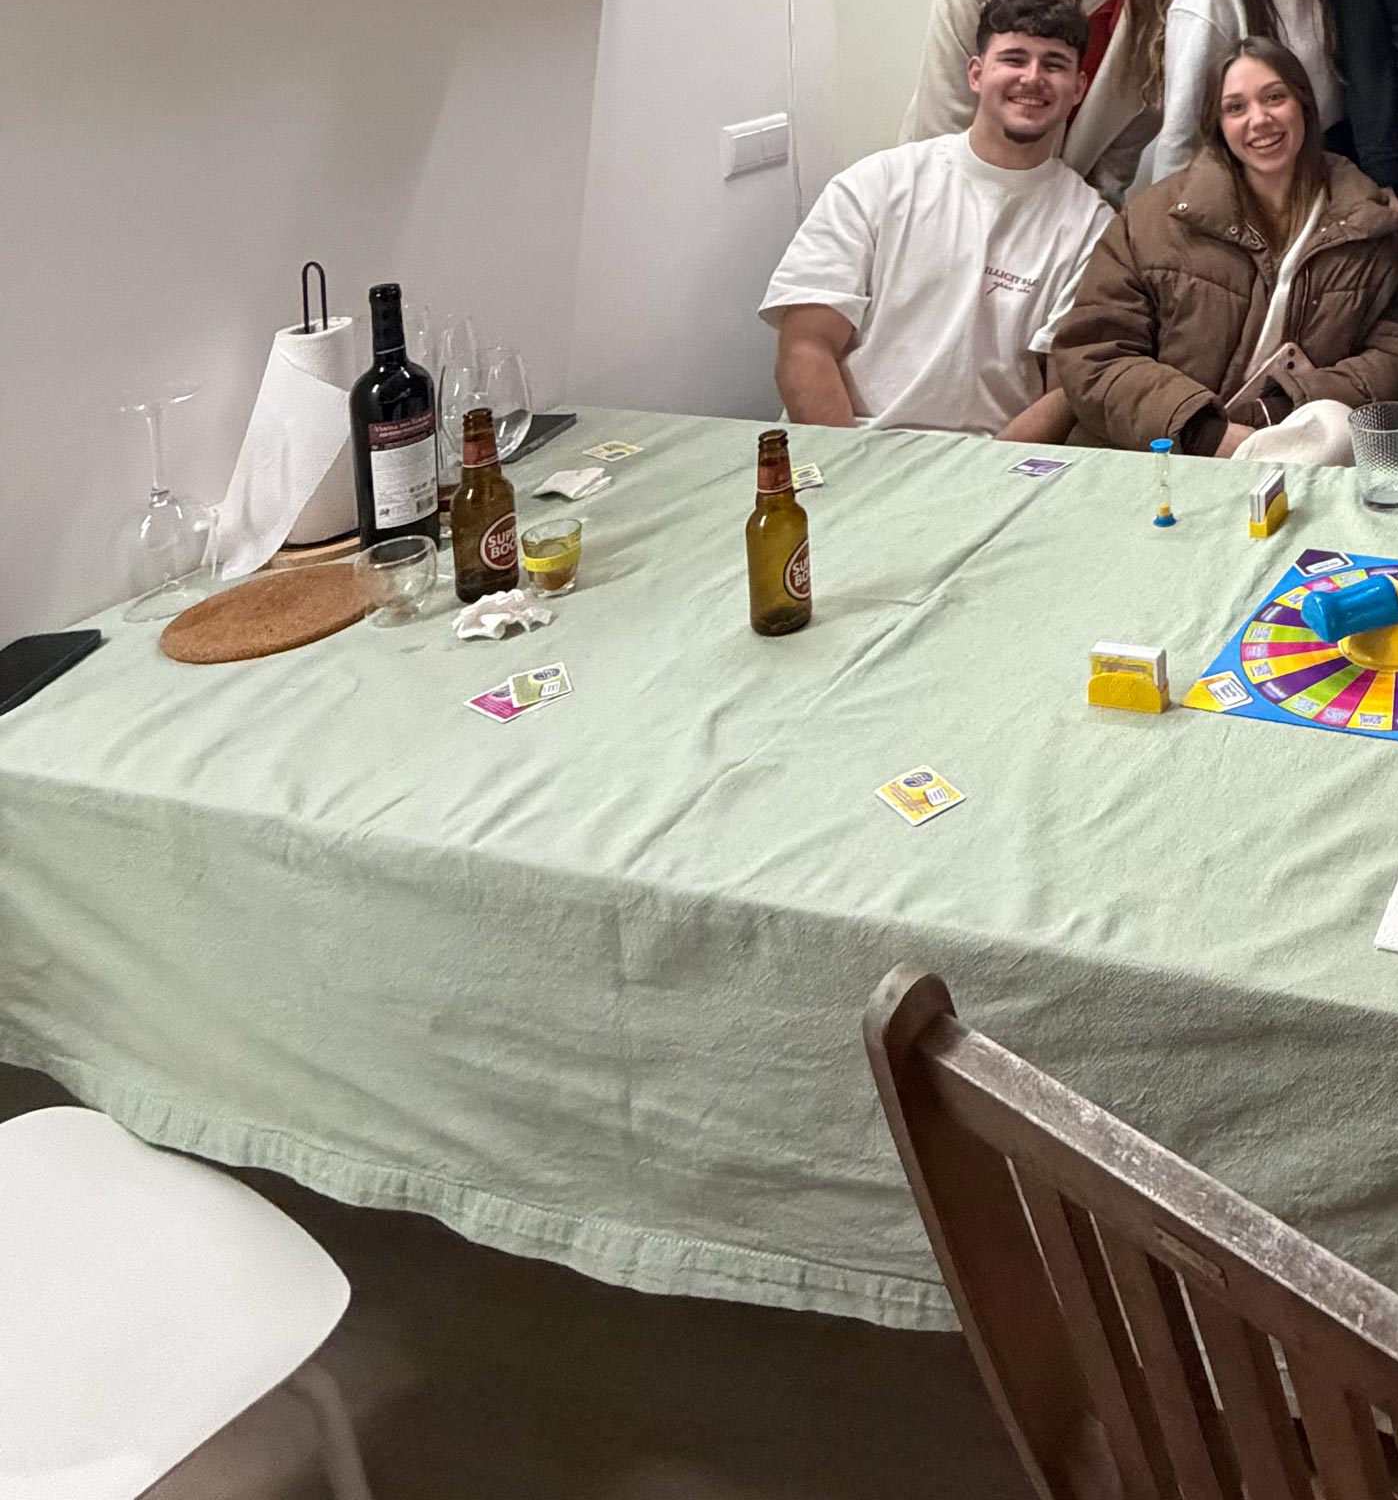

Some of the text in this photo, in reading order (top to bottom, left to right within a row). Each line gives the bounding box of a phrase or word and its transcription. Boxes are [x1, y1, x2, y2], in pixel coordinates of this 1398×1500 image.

[984, 266, 1021, 284] ILLICIT
[487, 528, 516, 548] SUPE
[489, 539, 517, 559] BOC
